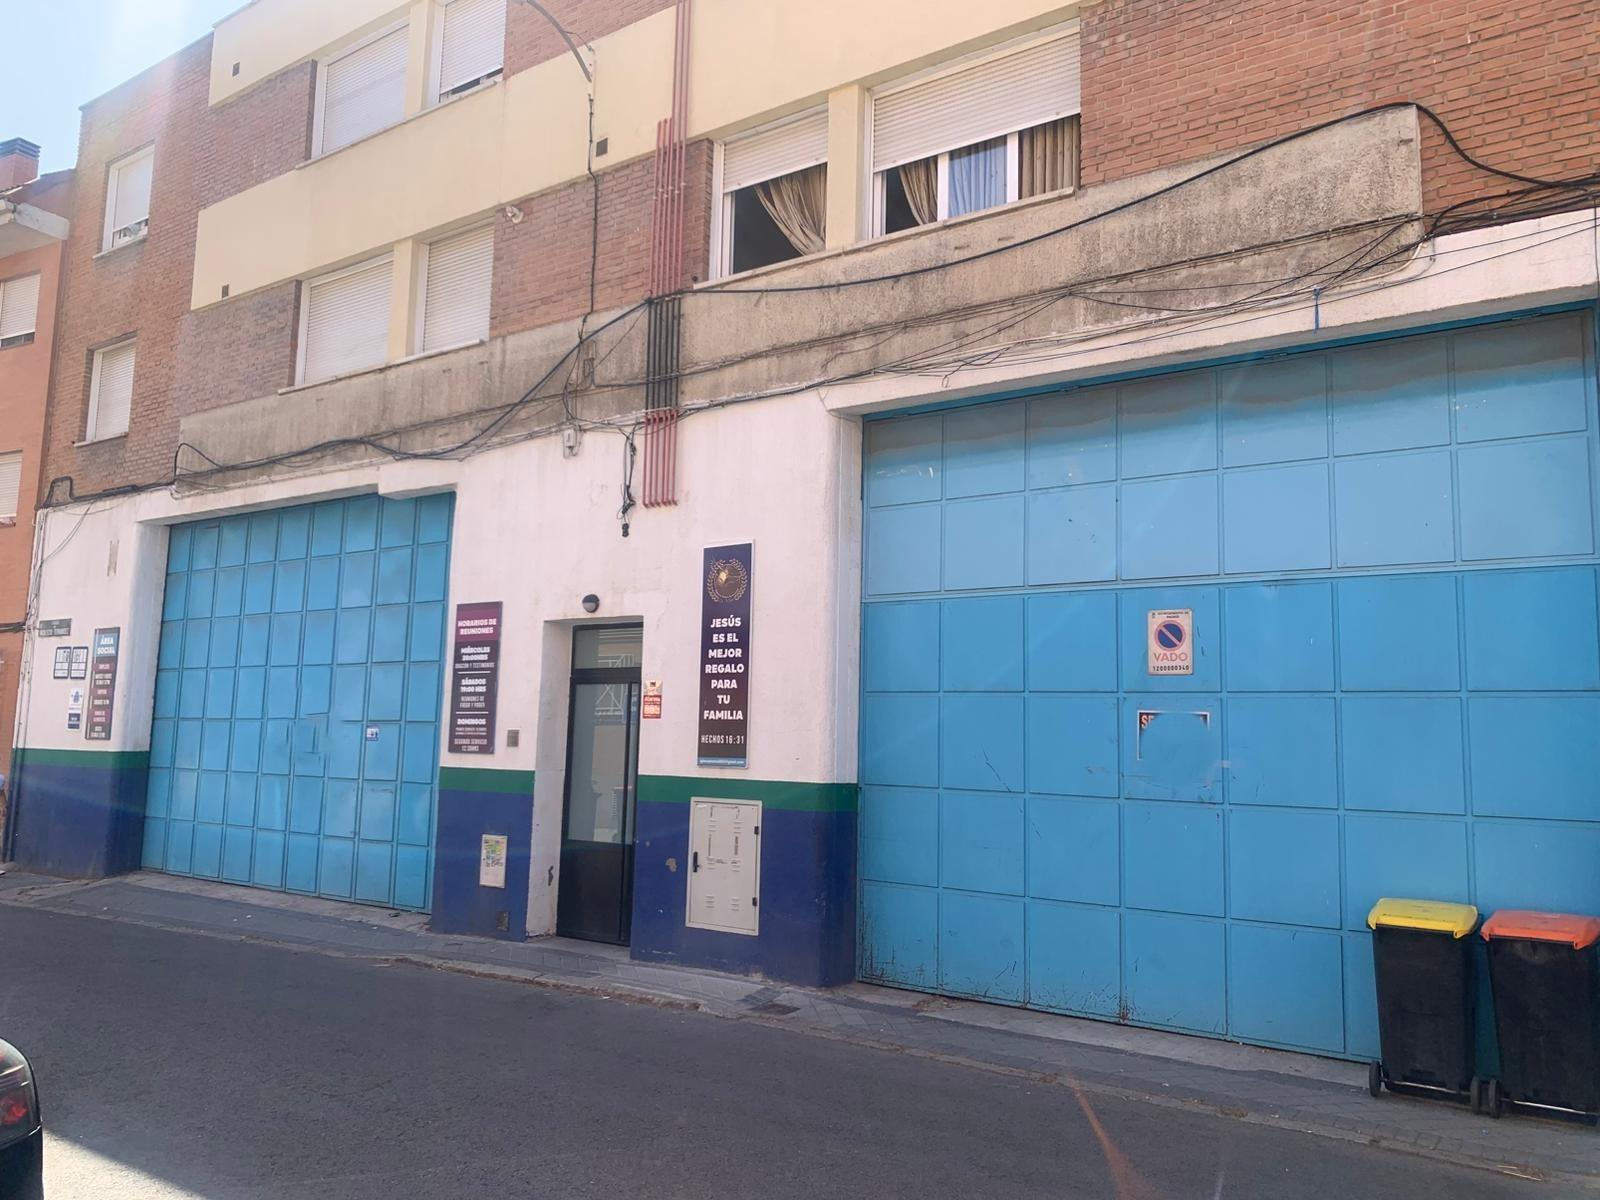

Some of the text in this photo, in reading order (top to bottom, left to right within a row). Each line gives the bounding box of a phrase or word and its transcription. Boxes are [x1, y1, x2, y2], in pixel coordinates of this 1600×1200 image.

[457, 618, 488, 627] HORARIOS
[710, 615, 741, 628] JESÚS
[459, 626, 494, 635] REUNIONES
[100, 635, 114, 645] ÁREA
[712, 633, 739, 643] ES EL
[96, 645, 115, 655] SOCIAL
[460, 645, 491, 654] MIÉRCOLES
[708, 648, 742, 659] MEJOR
[1153, 652, 1188, 662] VADO
[705, 664, 745, 674] REGALO
[461, 676, 486, 685] SÁBADOS
[711, 679, 738, 689] PARA
[717, 695, 731, 704] TU
[703, 710, 743, 720] FAMILIA
[701, 734, 744, 744] HECHOS 16:31
